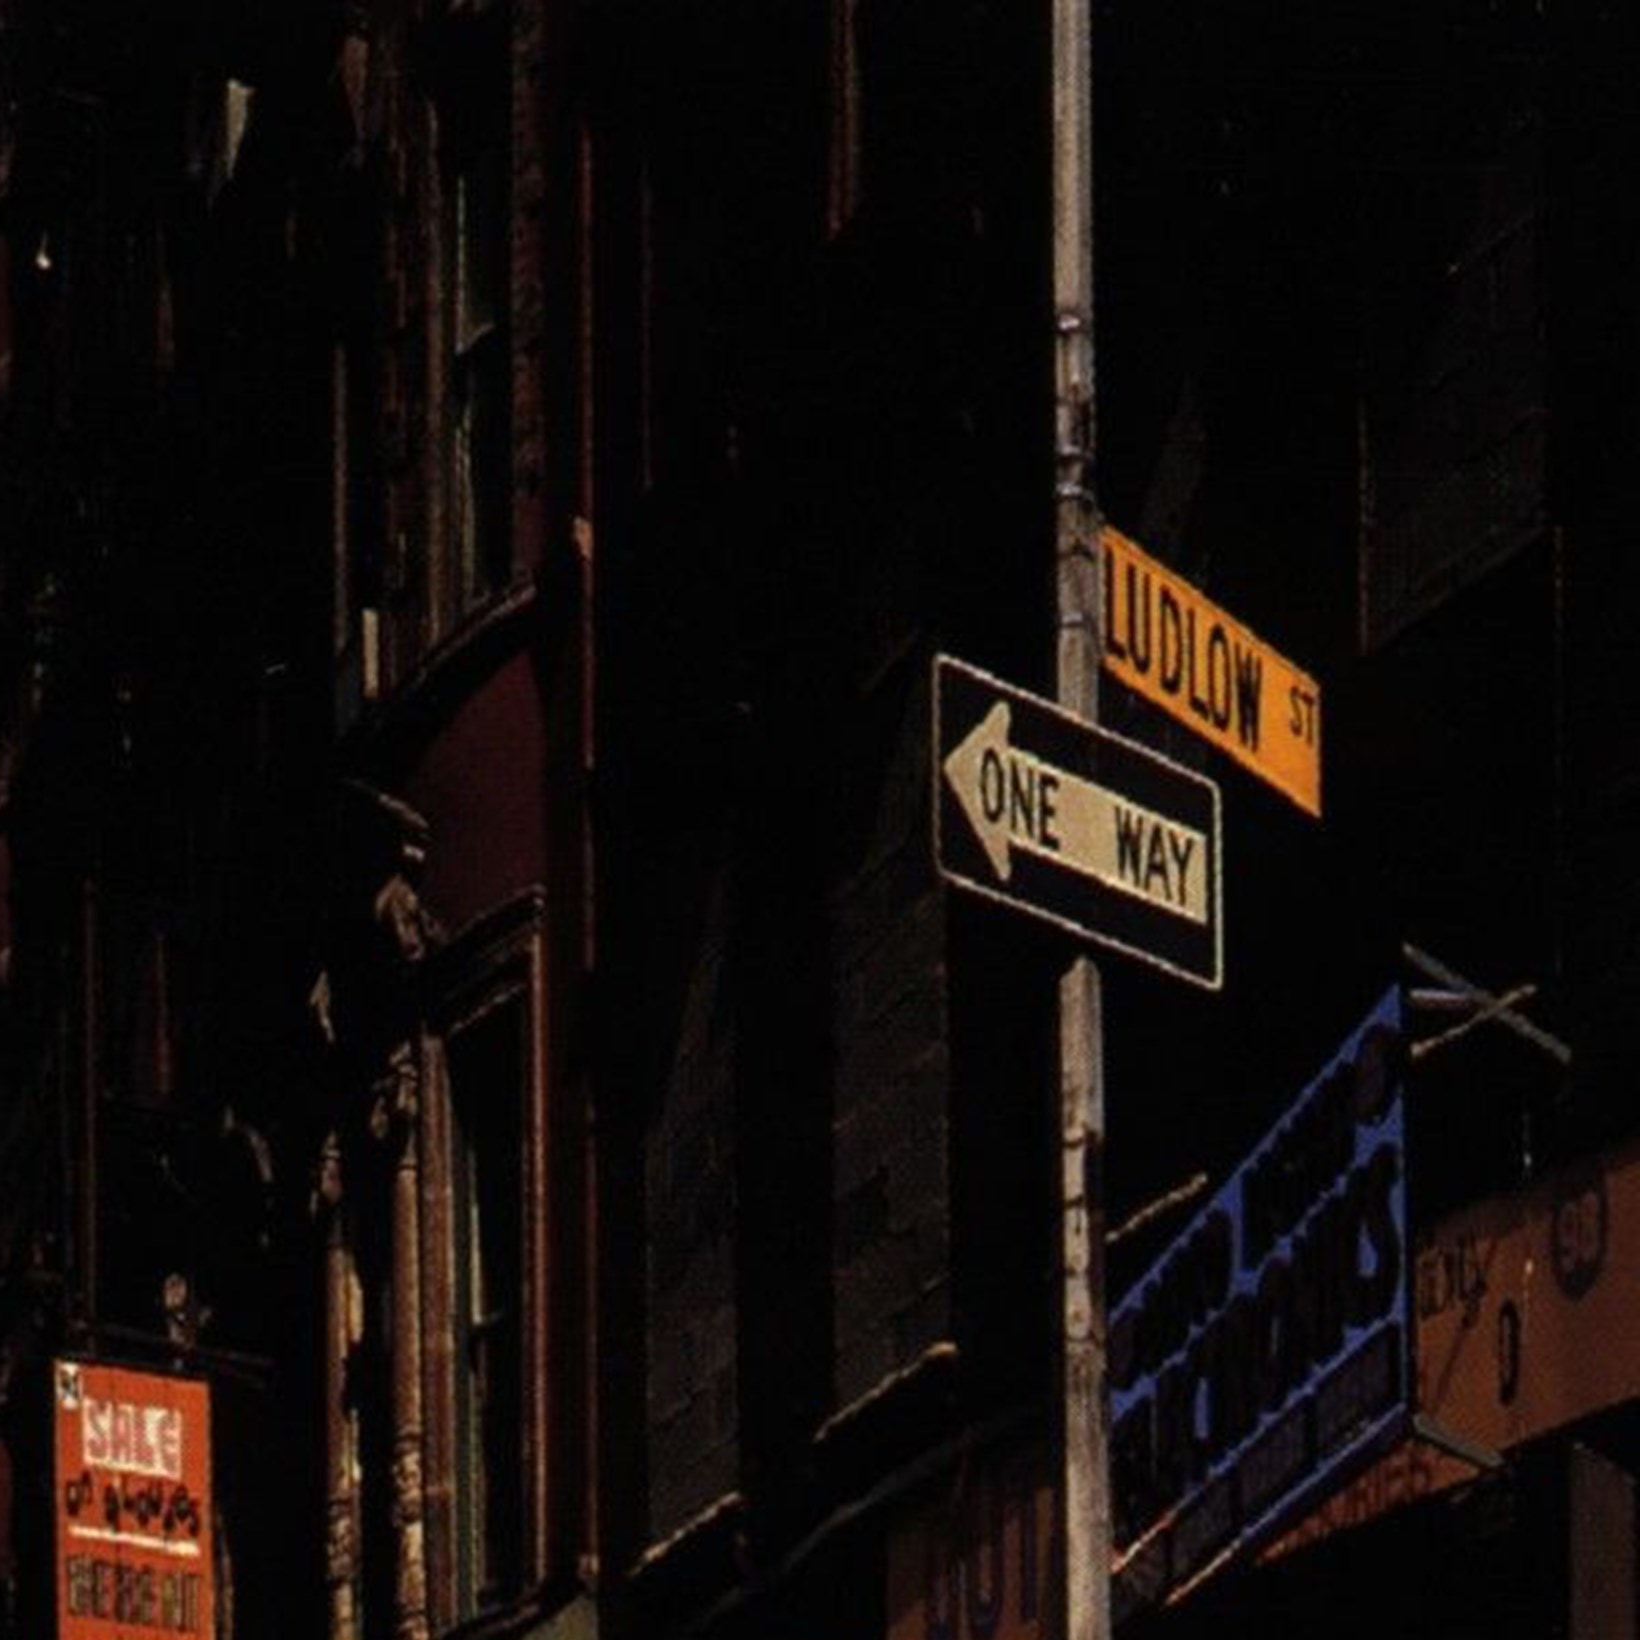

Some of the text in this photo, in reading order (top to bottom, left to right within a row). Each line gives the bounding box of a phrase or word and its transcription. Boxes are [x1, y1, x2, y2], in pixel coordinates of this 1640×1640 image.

[1104, 544, 1317, 756] LUDLOW ST
[979, 746, 1194, 907] ONE WAY
